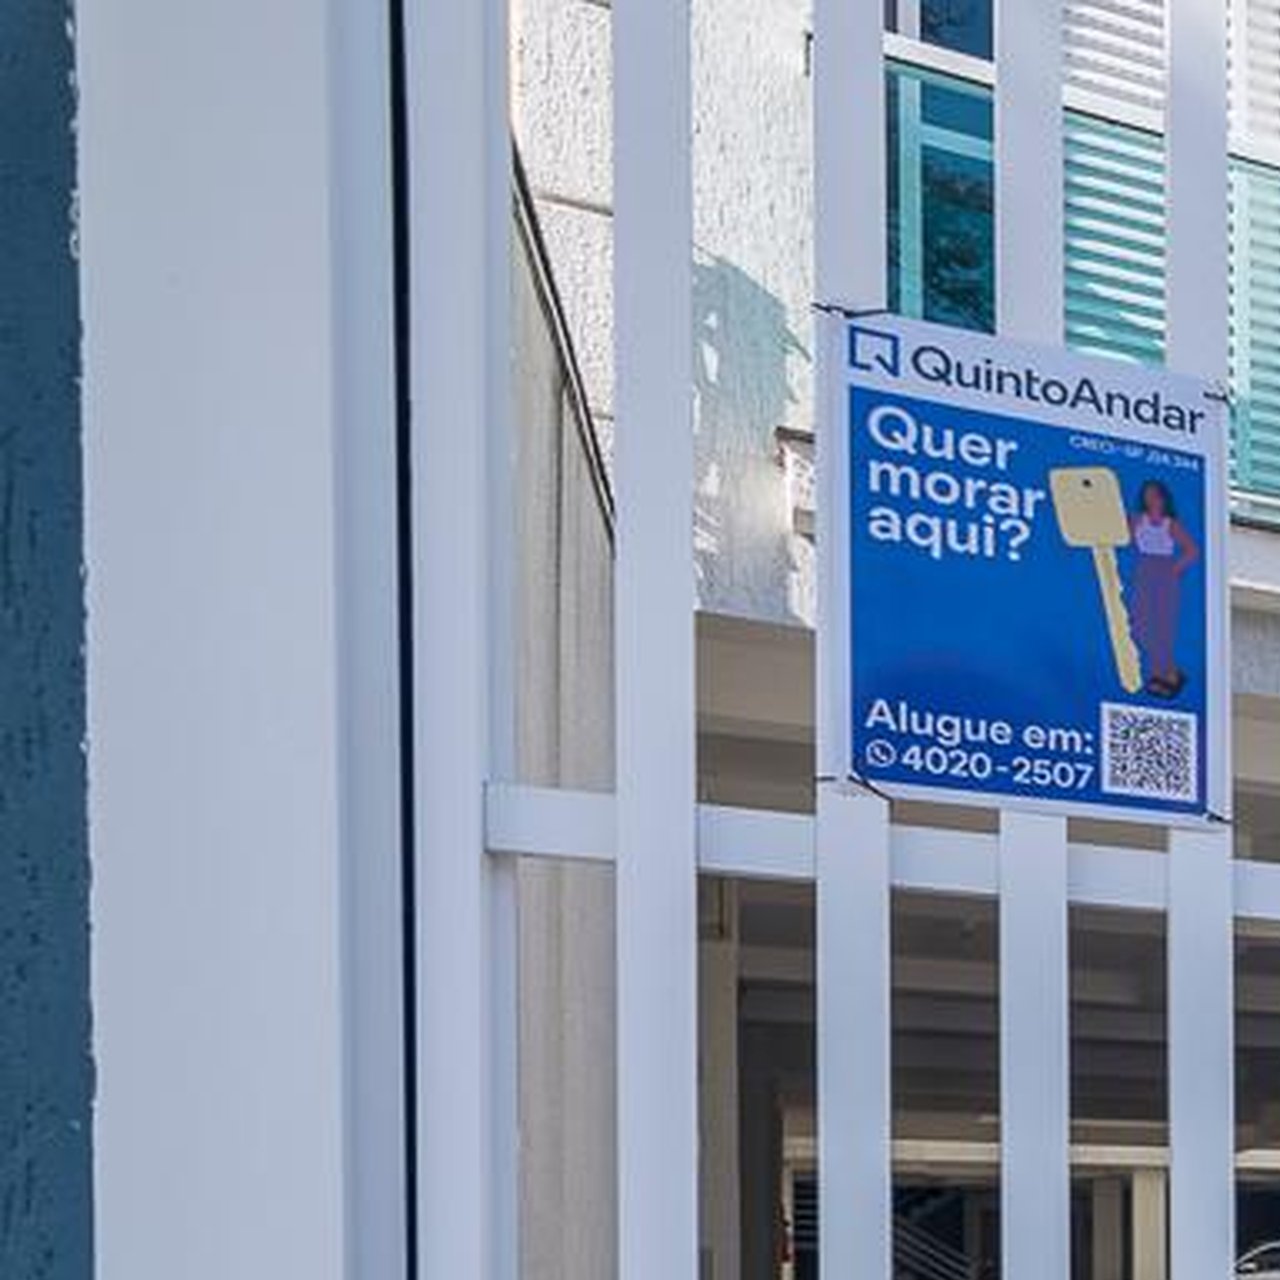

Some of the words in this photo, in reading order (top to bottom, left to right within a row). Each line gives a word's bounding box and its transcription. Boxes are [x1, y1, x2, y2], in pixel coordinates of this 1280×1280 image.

[911, 345, 1205, 434] QuintoAndar
[868, 405, 1018, 470] Quer
[868, 459, 1045, 520] morar
[869, 505, 1031, 561] aqui?
[865, 699, 1012, 747] Alugue
[1022, 724, 1094, 755] em:
[901, 745, 1095, 790] 4020-2507
